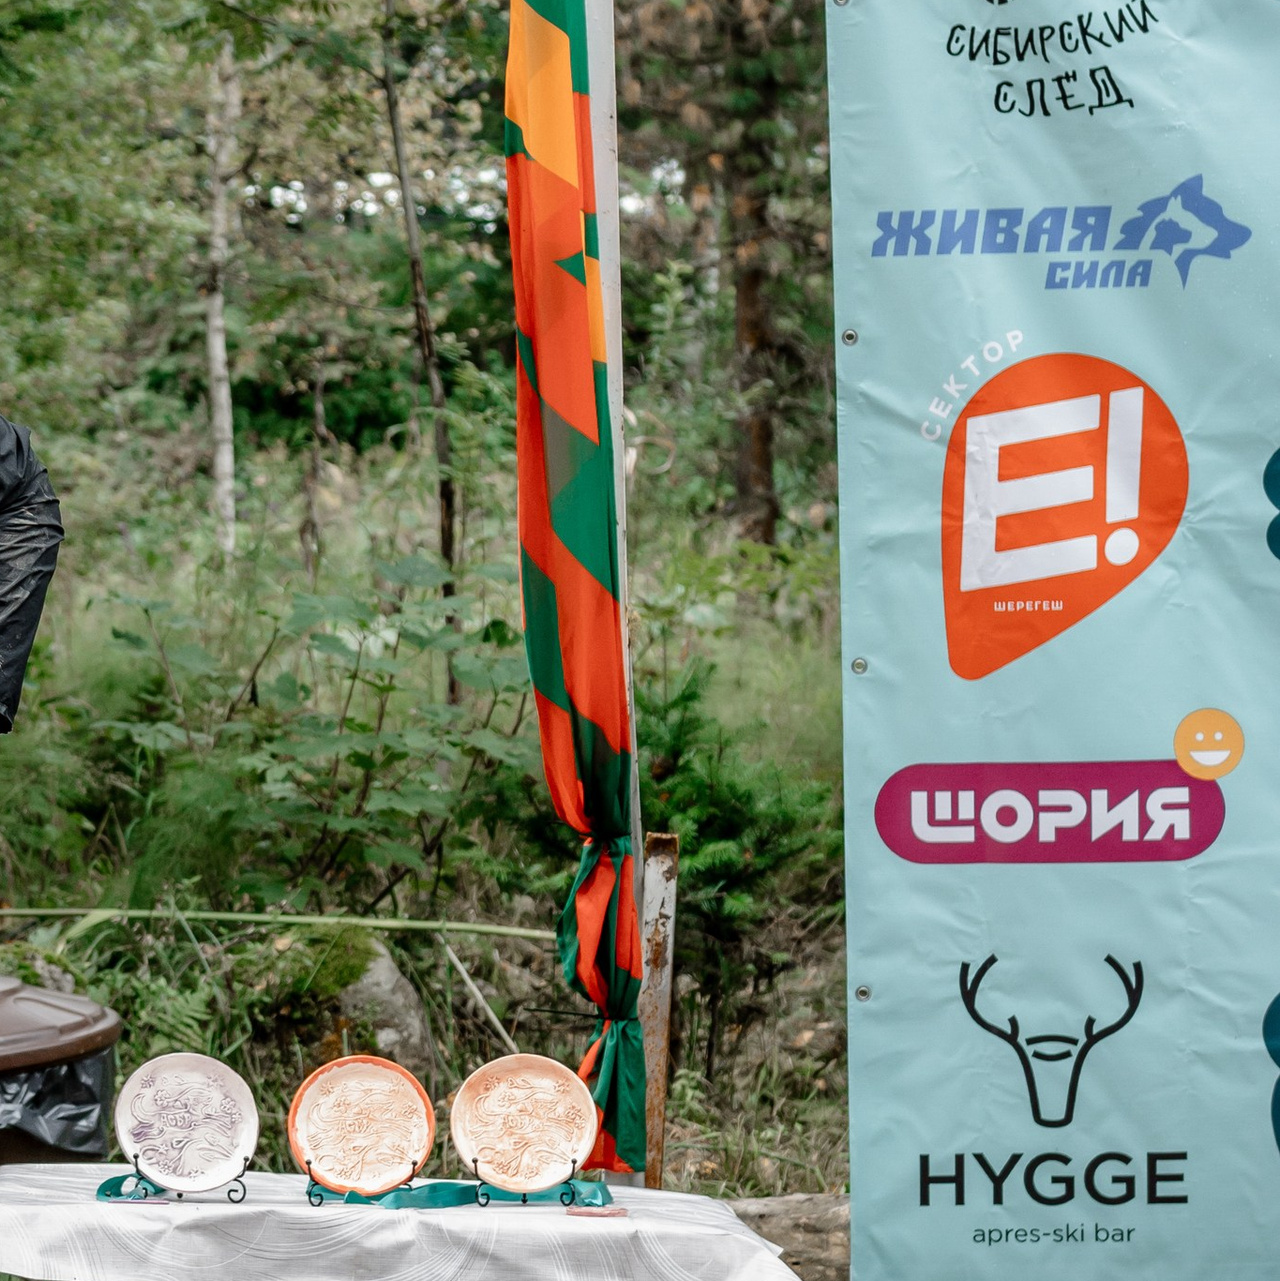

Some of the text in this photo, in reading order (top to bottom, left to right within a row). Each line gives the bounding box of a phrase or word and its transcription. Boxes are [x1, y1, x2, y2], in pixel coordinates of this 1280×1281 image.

[871, 206, 1112, 257] ЖИВАЯ
[1045, 259, 1153, 290] СИЛА
[920, 329, 1024, 442] СЕКТОР
[994, 600, 1064, 612] ШЕРЕГЕШ
[911, 786, 1191, 844] ШОРИЯ
[919, 1152, 1189, 1207] HYGGE
[973, 1224, 1136, 1246] apres-ski bar
